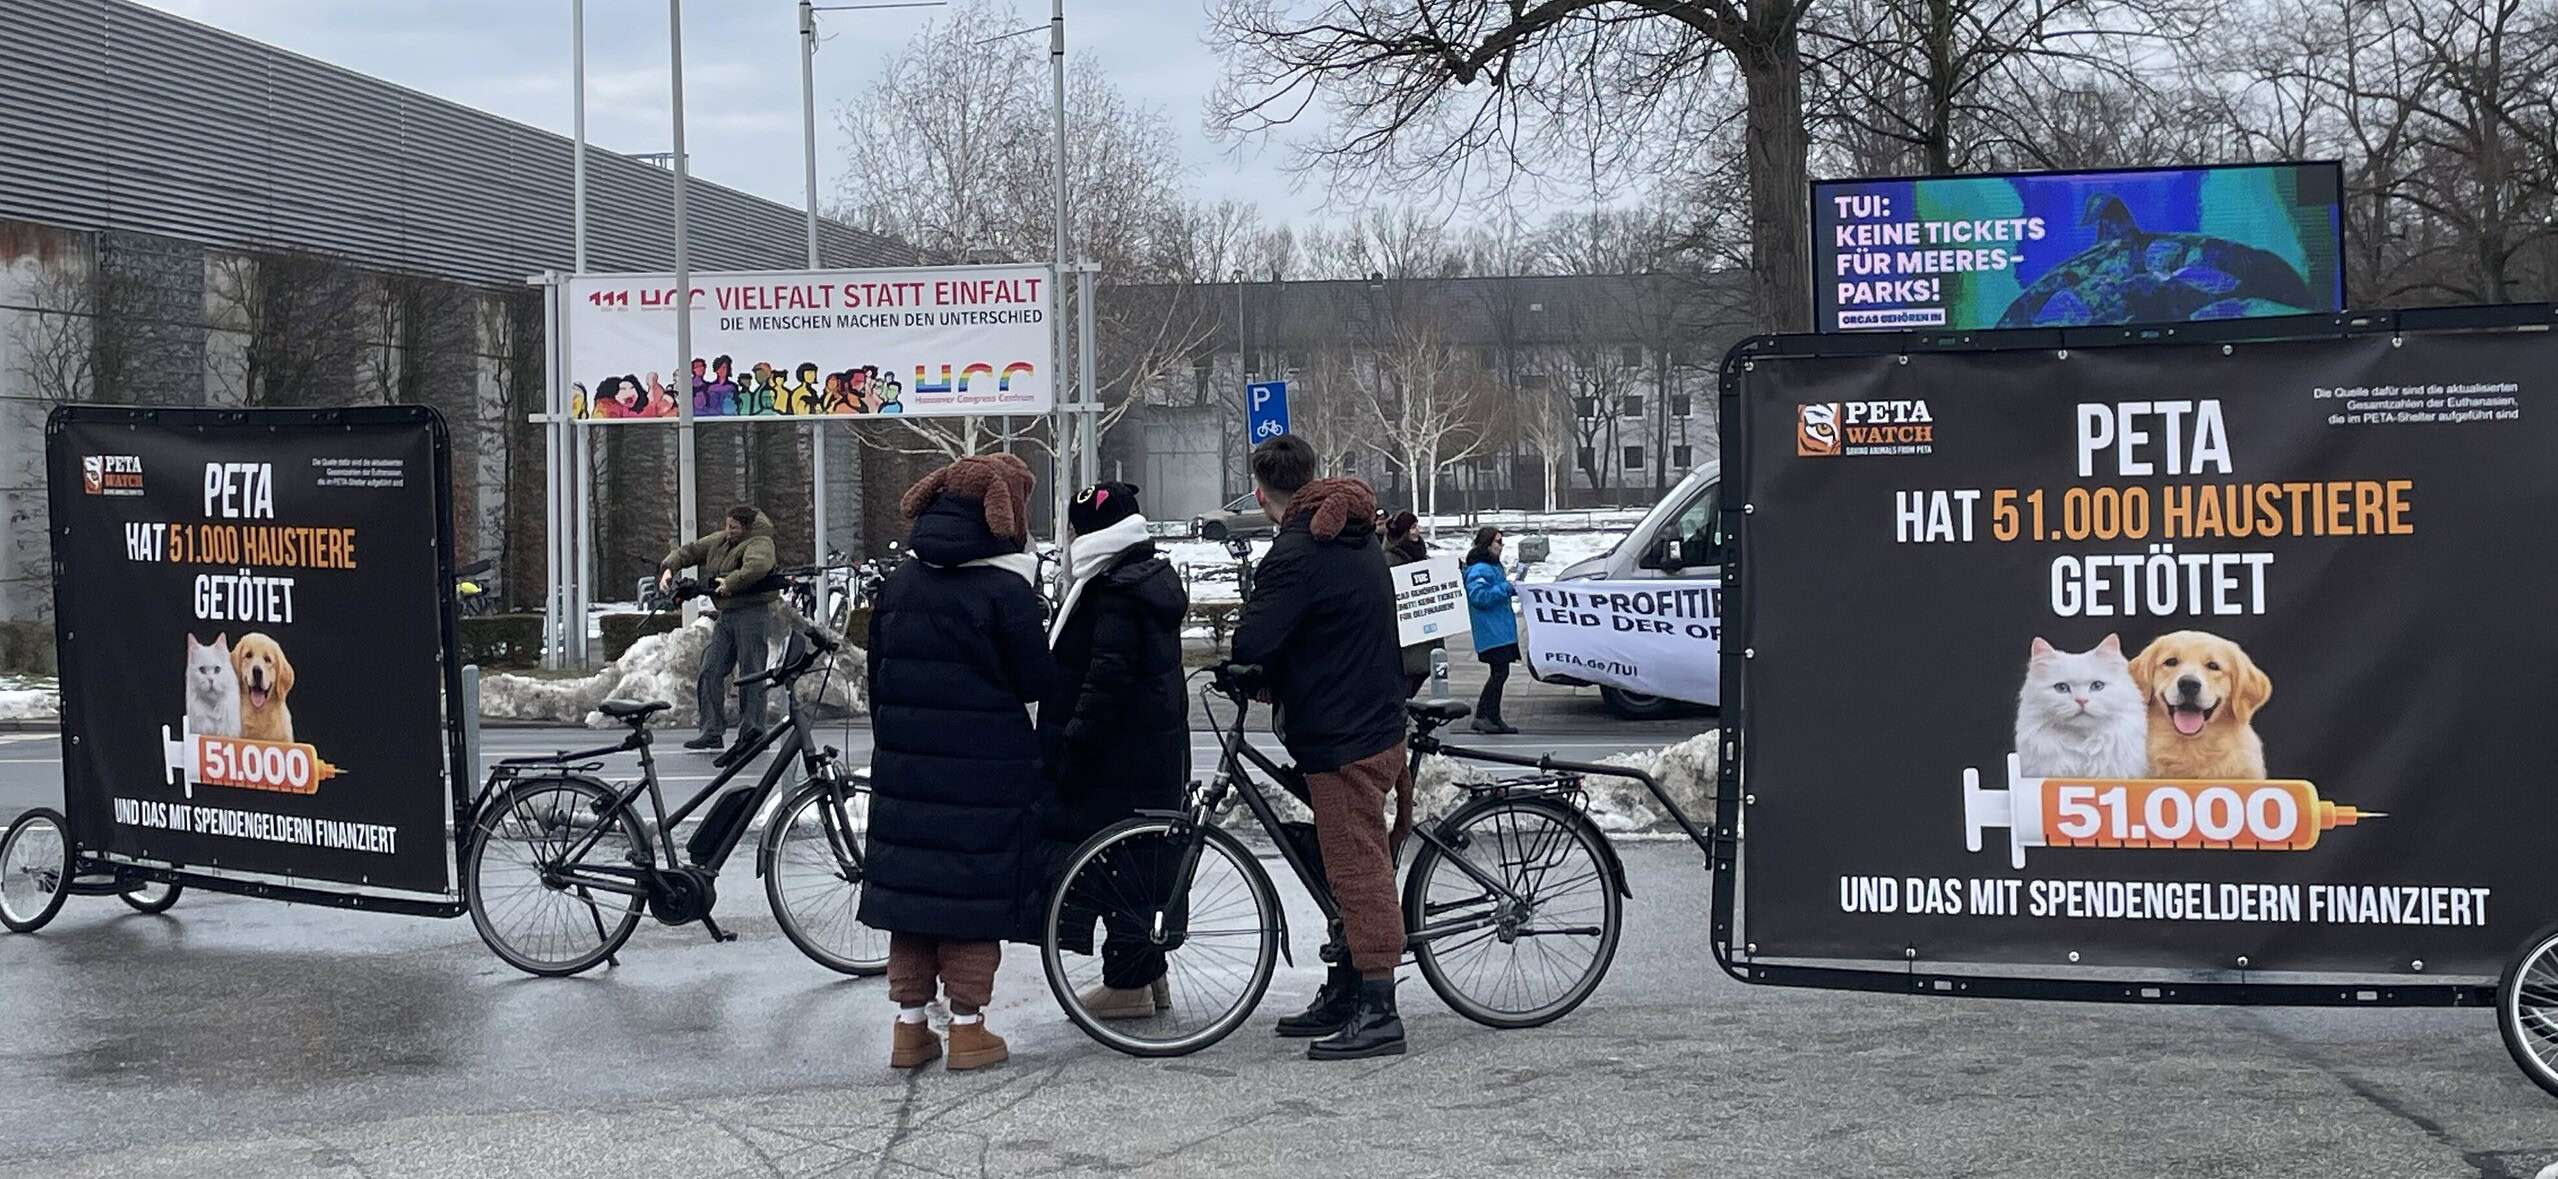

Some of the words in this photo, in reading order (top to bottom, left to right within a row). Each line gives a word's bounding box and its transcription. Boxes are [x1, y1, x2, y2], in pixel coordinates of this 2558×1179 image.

[1834, 195, 1891, 219] TUI:
[1836, 222, 1920, 247] KEINE
[1924, 217, 2046, 244] TICKETS
[1837, 247, 1892, 276] FÜR
[1897, 248, 2025, 274] MEERES-
[715, 284, 835, 310] VIELFALT
[843, 282, 925, 308] STATT
[935, 279, 1042, 306] EINFALT
[1838, 278, 1940, 304] PARKS!
[720, 317, 744, 331] DIE
[750, 315, 832, 330] MENSCHEN
[837, 313, 899, 328] MACHEN
[904, 311, 934, 326] DEN
[939, 309, 1042, 325] UNTERSCHIED
[1842, 315, 1879, 325] ORCAS
[1253, 387, 1270, 412] P
[2314, 388, 2332, 399] Die
[2334, 387, 2369, 399] Quelle
[2371, 385, 2399, 397] dafür
[2402, 385, 2424, 396] sind
[2427, 384, 2443, 395] die
[2347, 399, 2424, 411] Gesamtzahlen
[2426, 398, 2445, 409] der
[1845, 400, 1933, 424] PETA
[2328, 414, 2345, 425] die
[2347, 414, 2361, 424] im
[2363, 411, 2435, 424] PETA-Shelter
[2438, 410, 2493, 423] aufgeführt
[2496, 409, 2519, 420] sind
[1846, 426, 1933, 444] WATCH
[2077, 399, 2233, 477] PETA
[105, 456, 142, 472] PETA
[104, 474, 143, 488] WATCH
[204, 462, 274, 519] PETA
[1896, 490, 1981, 542] HAT
[1992, 486, 2149, 541] 51.000
[2163, 480, 2414, 539] HAUSTIERE
[125, 522, 166, 562] HAT
[169, 523, 240, 565] 51.000
[242, 525, 357, 570] HAUSTIERE
[2051, 543, 2274, 617] GETÖTET
[194, 568, 295, 624] GETÖTET
[1528, 588, 1580, 608] TUI
[1536, 608, 1600, 627] LEID
[1612, 615, 1676, 636] DER
[1545, 652, 1638, 677] PETA.de/TUI
[205, 741, 309, 787] 51.000
[113, 797, 140, 826] UND
[142, 801, 167, 829] DAS
[169, 803, 192, 832] MIT
[194, 807, 313, 845] SPENDENGELDERN
[316, 820, 397, 854] FINANZIERT
[2056, 785, 2298, 842] 51.000
[1840, 876, 1899, 913] UND
[1906, 878, 1962, 915] DAS
[1969, 879, 2024, 917] MIT
[2029, 881, 2300, 923] SPENDENGELDERN
[2310, 885, 2490, 926] FINANZIERT
